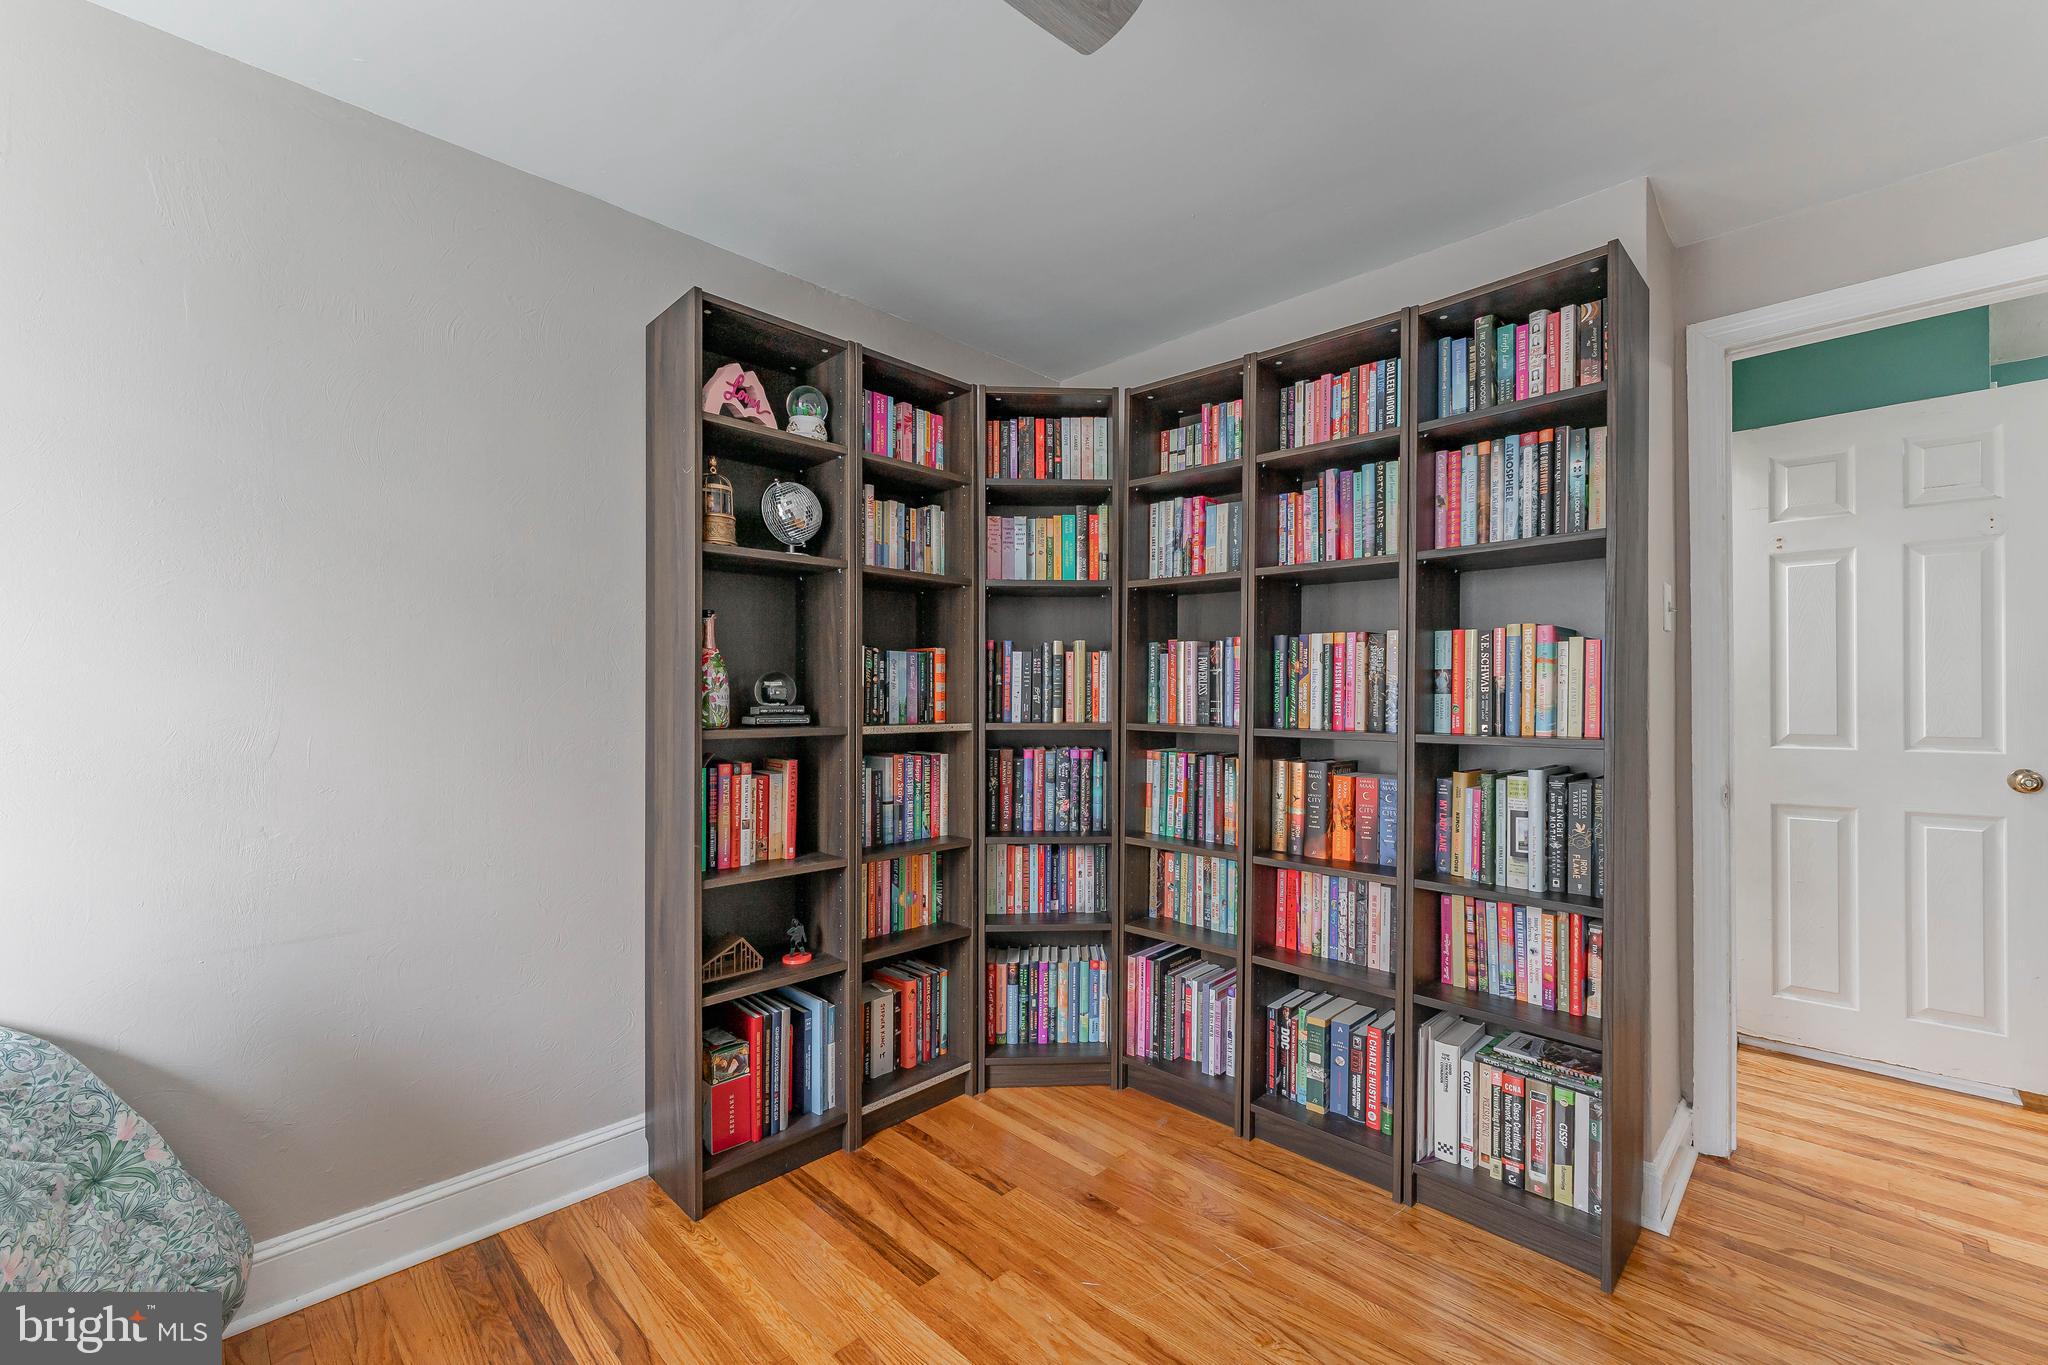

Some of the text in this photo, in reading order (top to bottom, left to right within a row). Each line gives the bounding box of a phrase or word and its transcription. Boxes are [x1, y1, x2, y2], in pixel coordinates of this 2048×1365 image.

[1500, 334, 1509, 353] Firefly
[1386, 362, 1395, 424] COLLEEN HOOVER
[1198, 657, 1207, 695] POWERLESS
[1481, 653, 1489, 692] SCHWAB
[1440, 800, 1447, 811] MY
[1281, 1027, 1290, 1049] DOC
[1369, 1078, 1377, 1109] HUSTLE
[1493, 1086, 1501, 1121] Networking
[1505, 1083, 1521, 1094] CCNA
[1482, 1096, 1490, 1137] UNIX SYSTEM
[1535, 1107, 1544, 1152] Network+
[1560, 1122, 1568, 1146] CISSP
